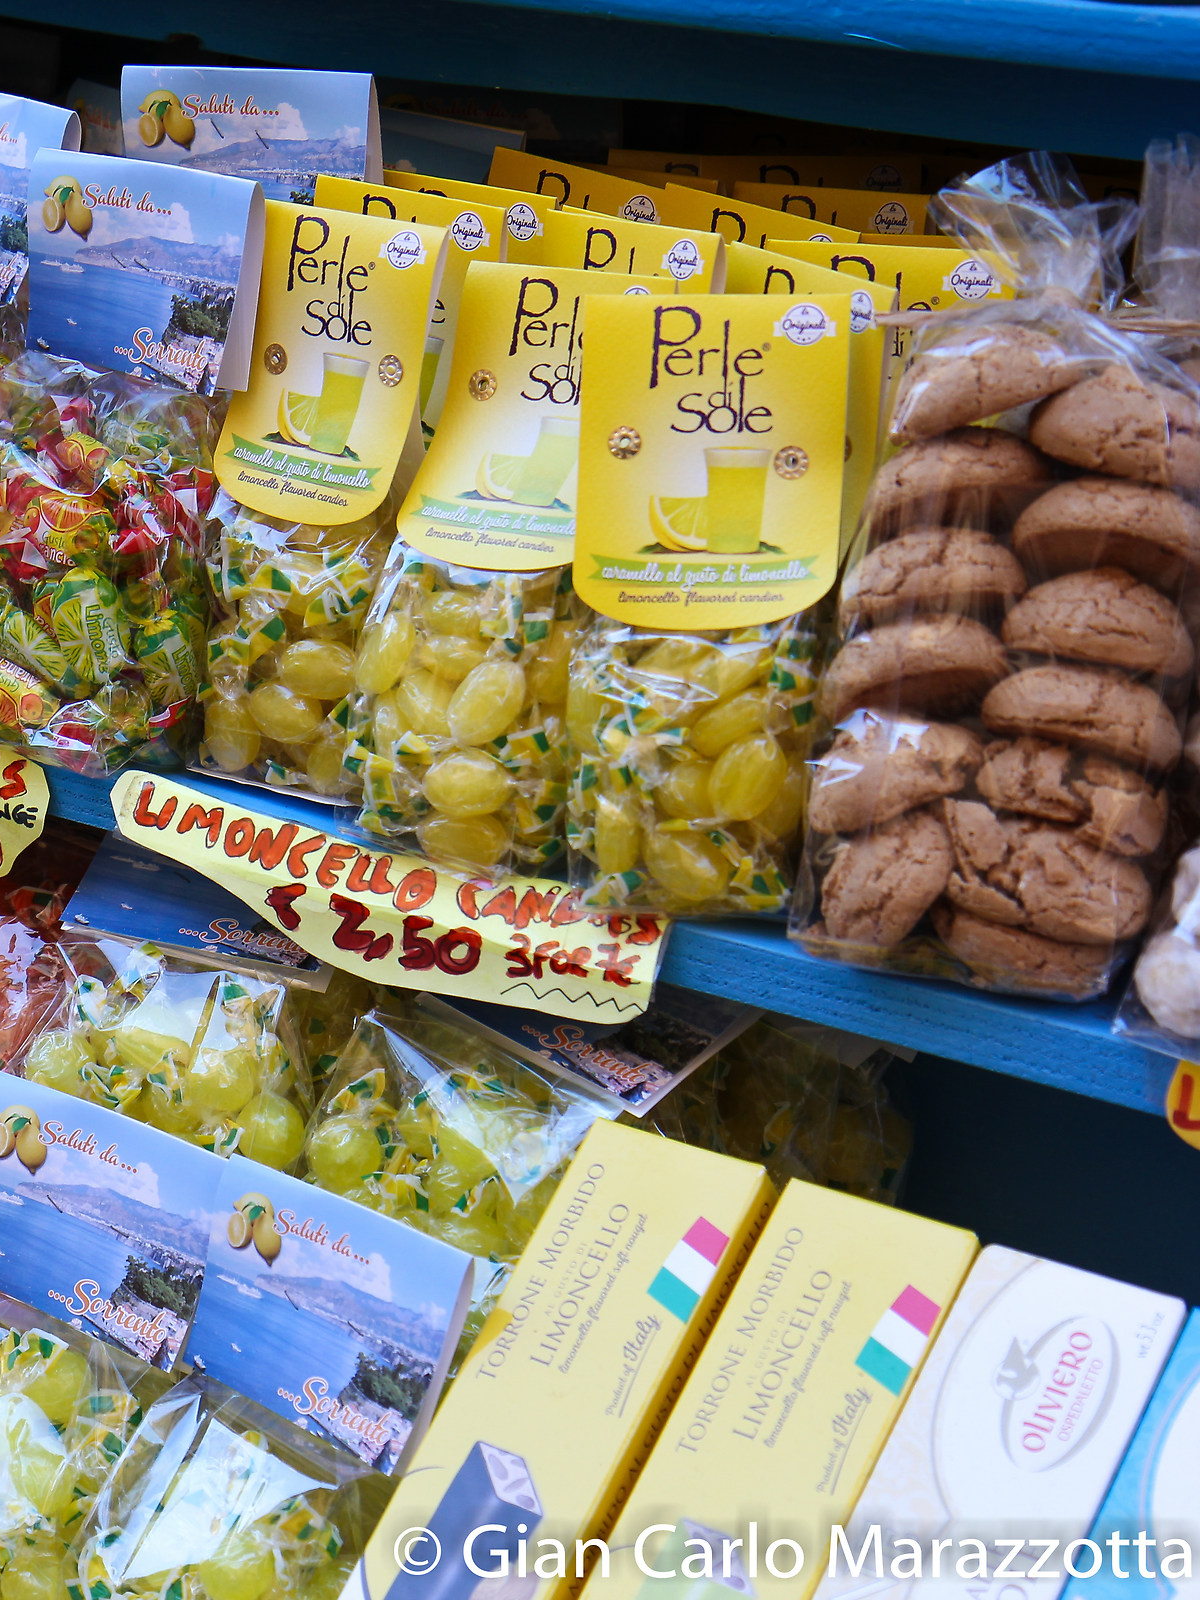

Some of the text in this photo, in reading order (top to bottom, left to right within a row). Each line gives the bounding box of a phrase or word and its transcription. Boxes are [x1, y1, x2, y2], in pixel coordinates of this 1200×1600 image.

[287, 214, 369, 292] Perle
[301, 289, 372, 346] sole
[509, 276, 583, 356] Perl
[650, 305, 764, 388] Perle
[520, 362, 581, 406] sol
[671, 376, 773, 434] sole
[133, 780, 438, 912] LIMONCELLO
[329, 893, 483, 976] 2,50
[476, 1163, 606, 1380] TORRONE MORBIDO
[530, 1203, 631, 1367] LIMONCELLO
[622, 1313, 662, 1362] Italy
[676, 1227, 804, 1453] TORRONE MORBIDO
[732, 1270, 833, 1441] LIMONCELLO
[832, 1386, 873, 1435] Italy
[1022, 1331, 1093, 1453] OLIVIERO
